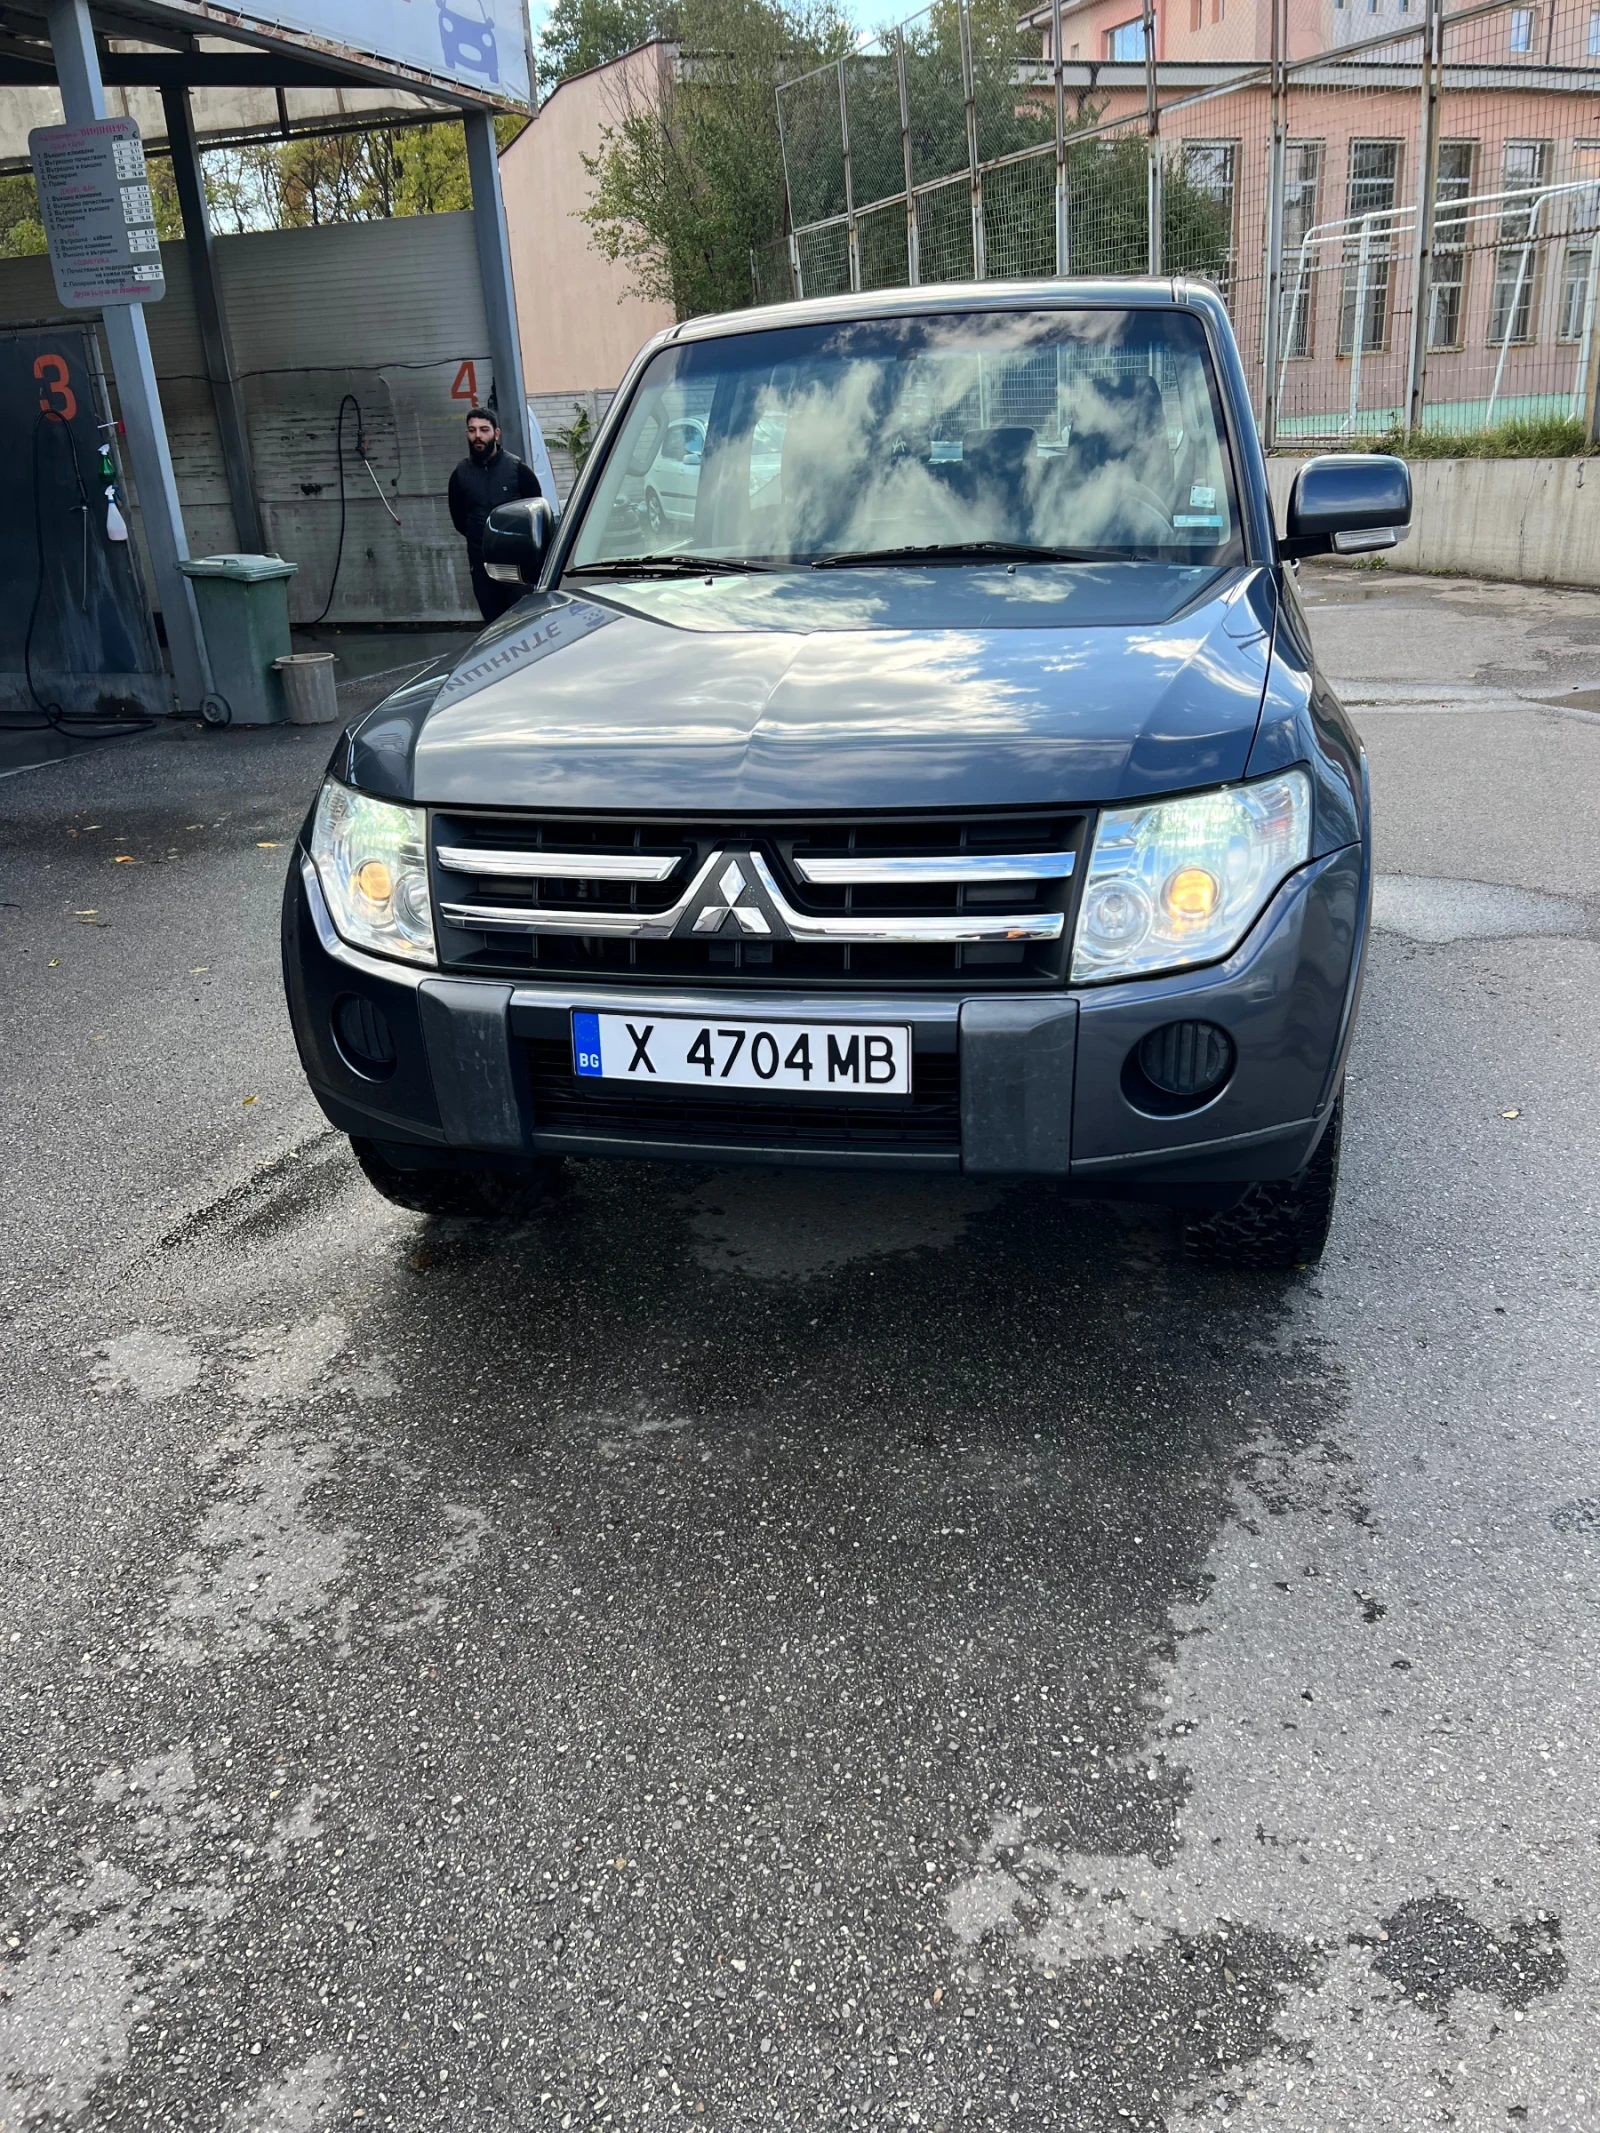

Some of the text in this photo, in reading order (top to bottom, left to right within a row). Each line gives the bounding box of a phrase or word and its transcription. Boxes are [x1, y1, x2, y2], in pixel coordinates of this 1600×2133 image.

[34, 354, 76, 421] 3
[451, 361, 478, 408] 4
[579, 1053, 599, 1068] BG
[625, 1023, 897, 1084] X 4704 MB
